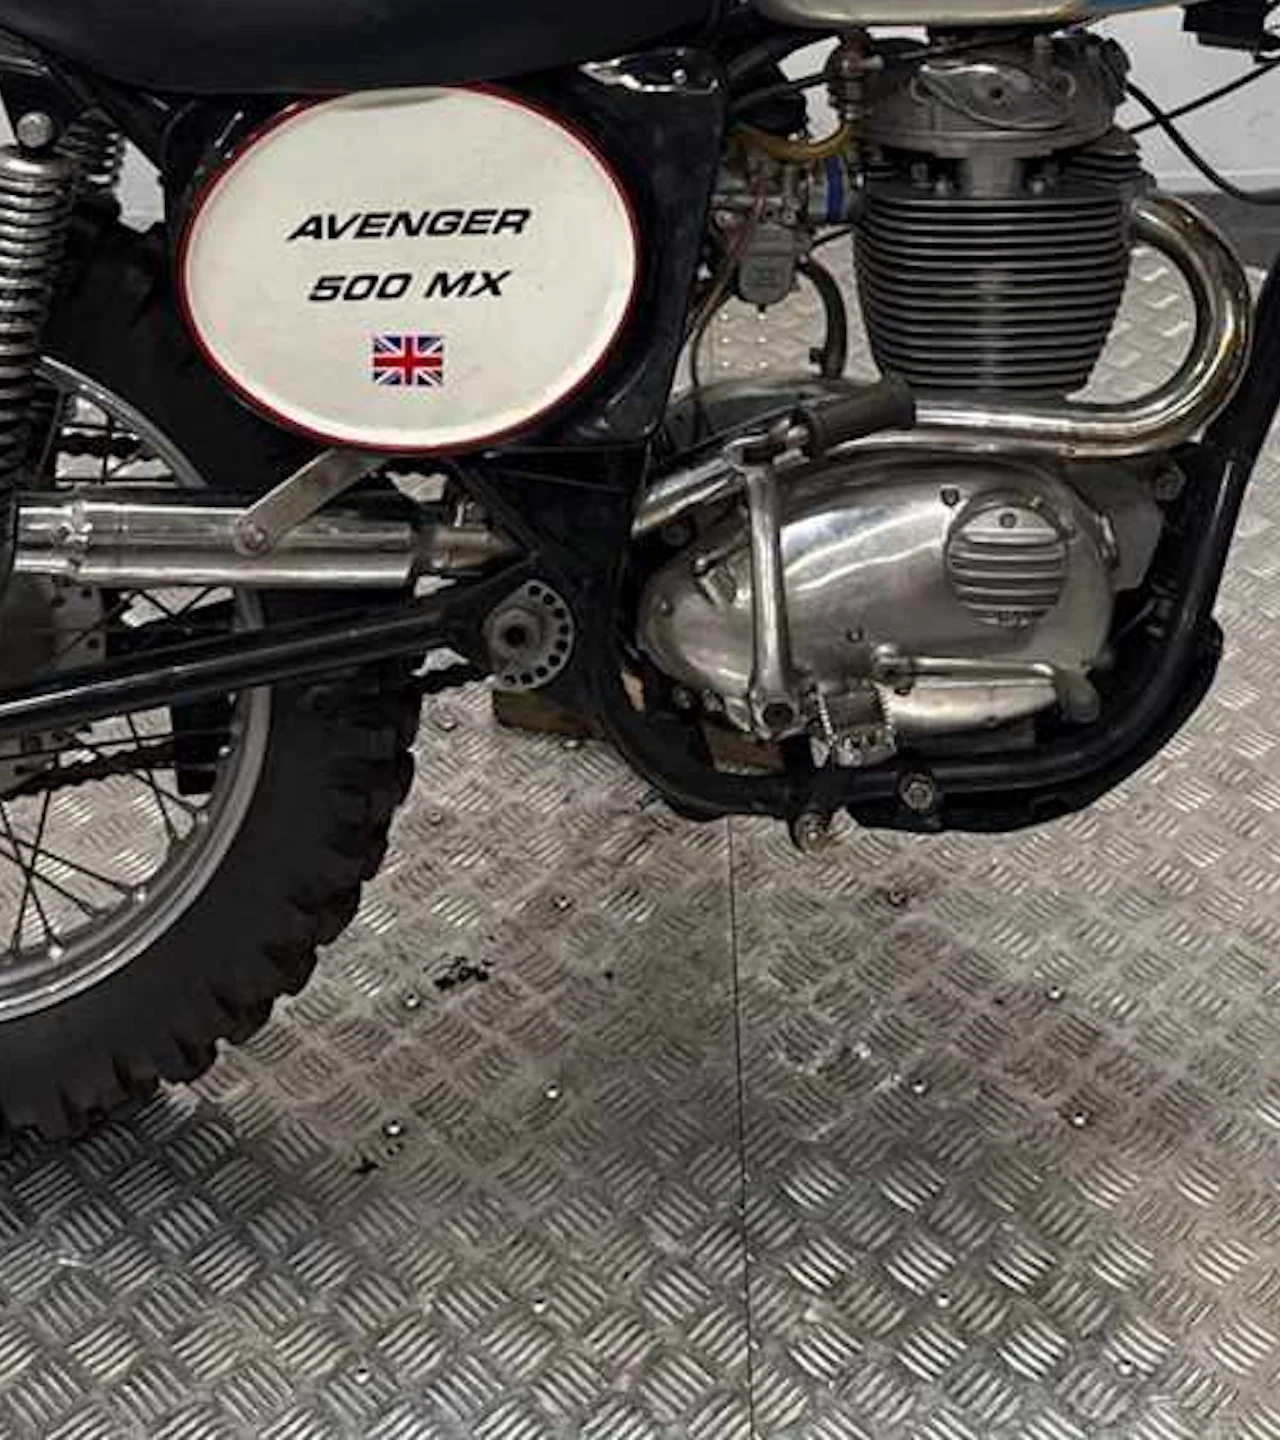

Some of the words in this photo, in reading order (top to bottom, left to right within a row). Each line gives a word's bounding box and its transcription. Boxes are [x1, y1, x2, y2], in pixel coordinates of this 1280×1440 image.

[286, 208, 533, 241] AVENGER
[307, 272, 413, 302] 500
[424, 269, 513, 299] MX
